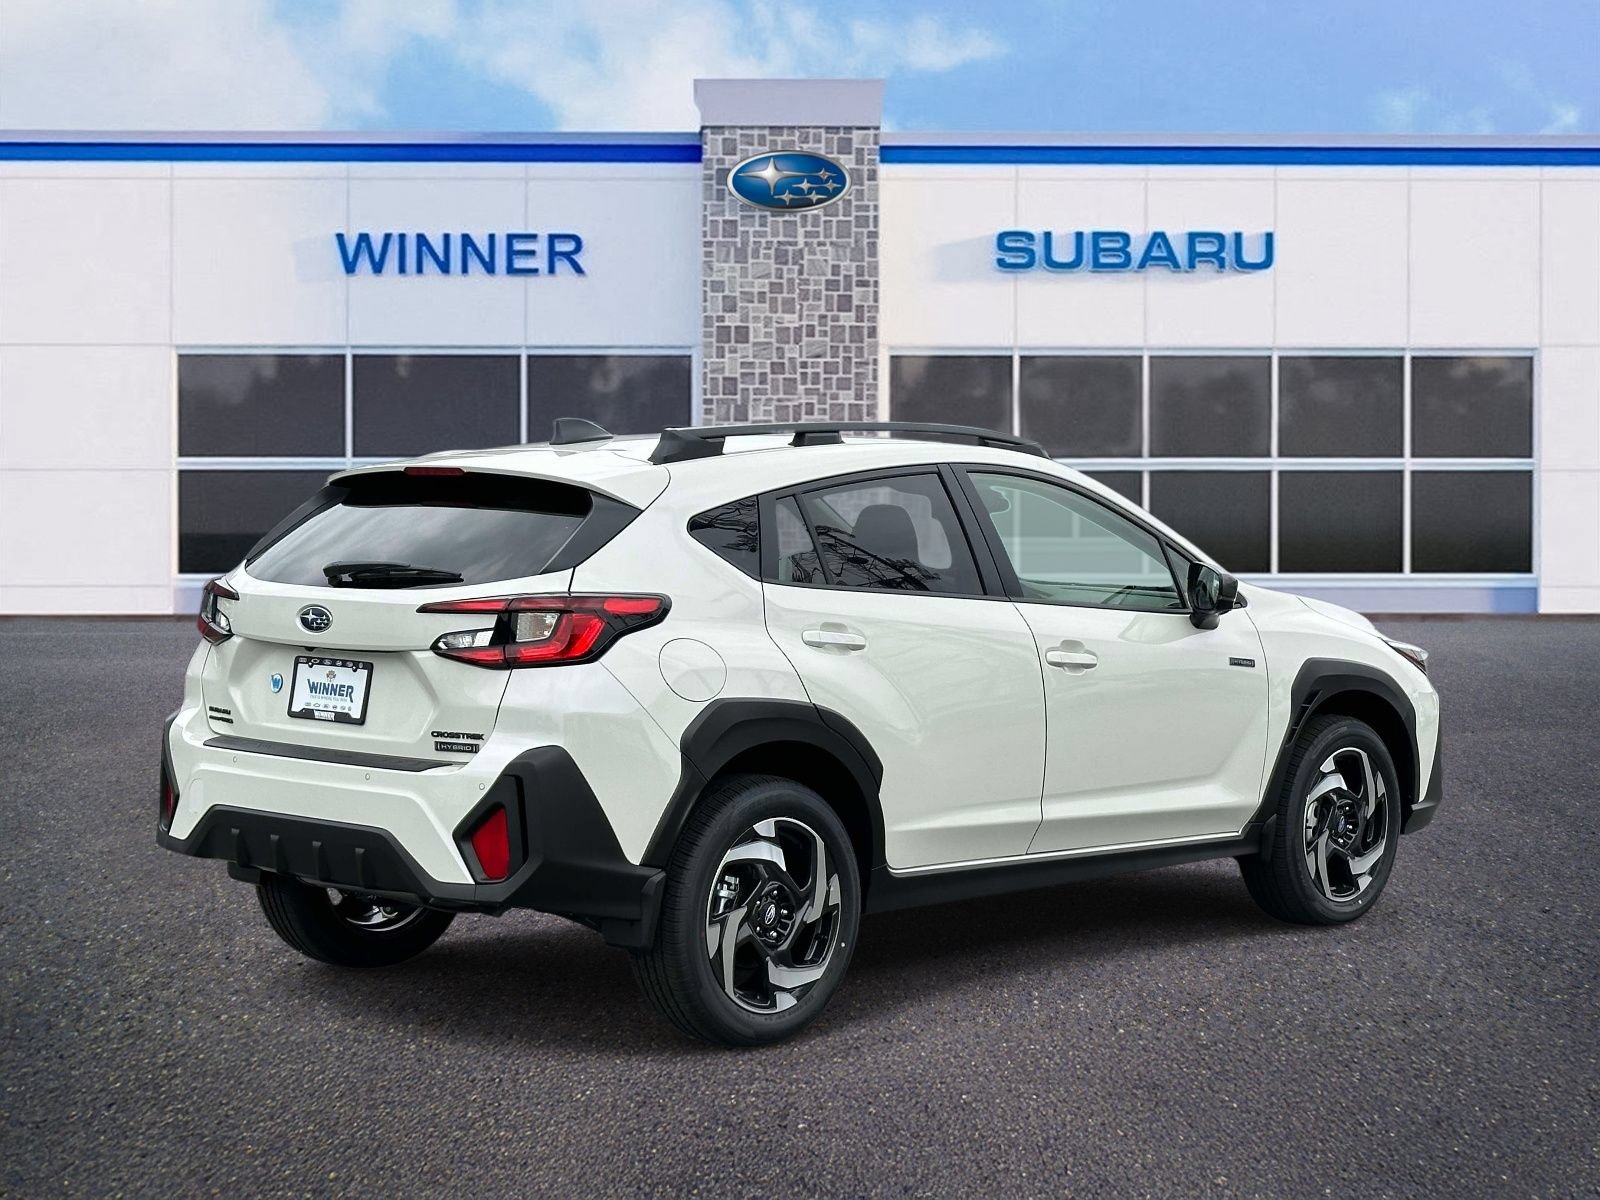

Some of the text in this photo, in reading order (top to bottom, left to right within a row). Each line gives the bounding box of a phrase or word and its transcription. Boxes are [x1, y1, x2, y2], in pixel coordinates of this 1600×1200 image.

[335, 232, 585, 275] WINNER
[996, 230, 1274, 270] SUBARU
[307, 678, 354, 703] WINNER
[430, 730, 485, 741] CROSSTREK
[439, 743, 473, 752] HYBRID
